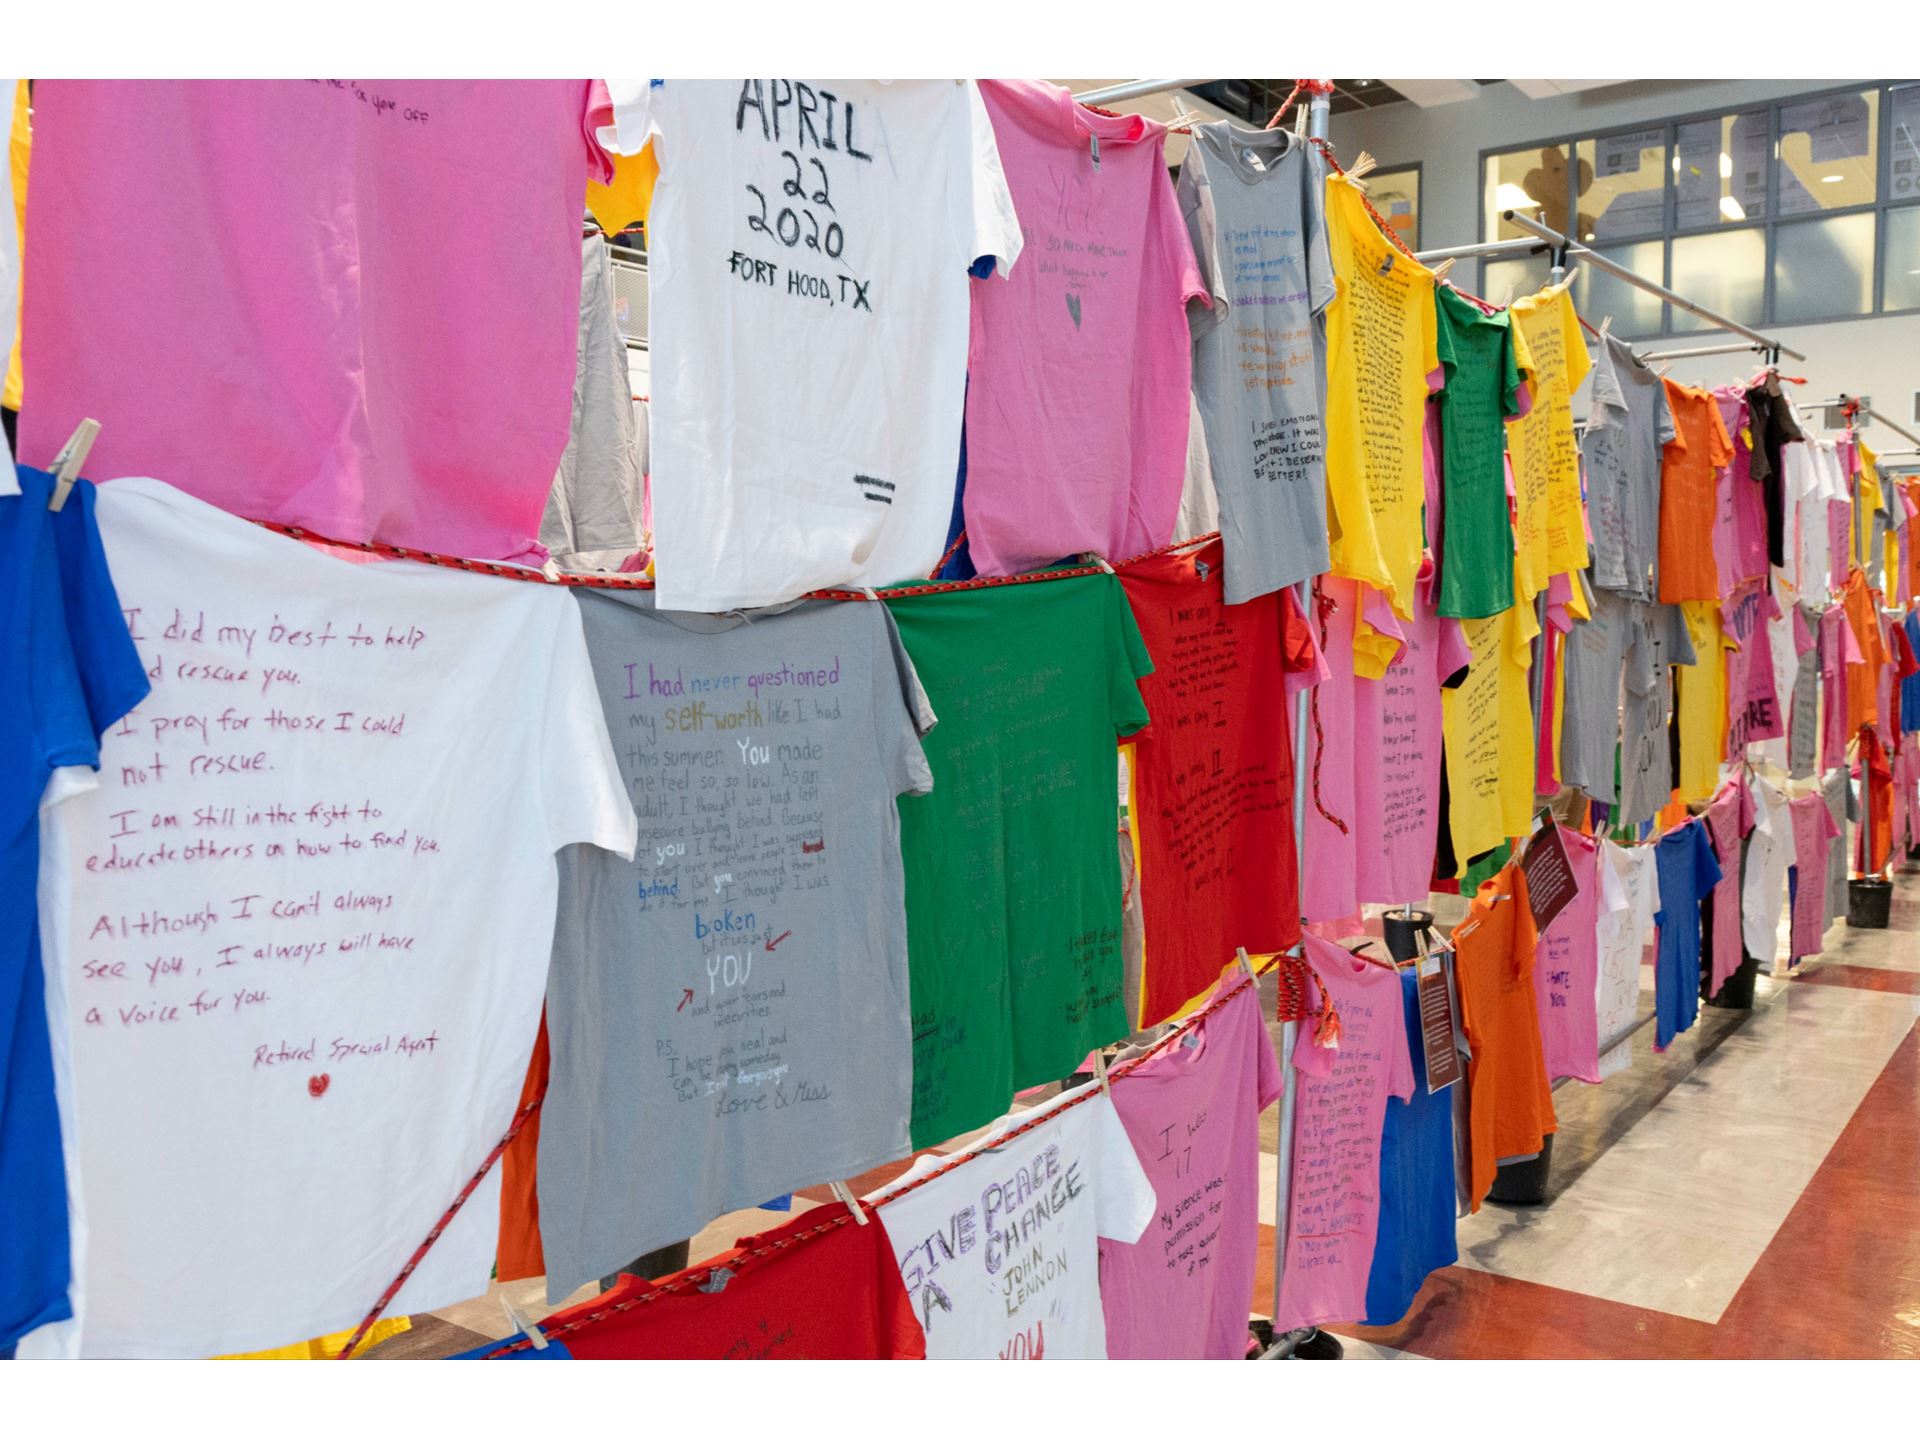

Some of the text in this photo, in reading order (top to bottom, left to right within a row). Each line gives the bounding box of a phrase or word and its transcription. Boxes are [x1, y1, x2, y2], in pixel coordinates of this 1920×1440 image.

[736, 79, 873, 162] APRIL
[782, 150, 836, 214] 22
[746, 184, 843, 258] 2020
[727, 251, 777, 286] FORT
[838, 275, 872, 313] TX
[122, 607, 146, 641] I
[164, 609, 204, 642] did
[218, 625, 256, 658] my
[348, 624, 374, 645] to
[385, 626, 425, 650] help
[177, 664, 249, 681] rescue
[263, 668, 301, 696] you.
[623, 655, 840, 699] I had never questioned
[116, 708, 405, 744] I pray for those I could
[629, 714, 656, 745] my
[768, 699, 789, 724] like
[794, 698, 806, 723] I
[815, 698, 841, 720] had
[122, 752, 274, 787] not rescue.
[627, 746, 658, 768] this
[737, 737, 770, 765] You
[777, 738, 823, 760] made
[633, 776, 654, 791] me
[661, 769, 689, 790] feel
[726, 777, 739, 786] so
[109, 810, 137, 838] I
[151, 814, 177, 828] am
[305, 802, 351, 827] fight
[358, 801, 382, 819] to
[696, 791, 736, 817] thought
[86, 844, 176, 871] educate
[184, 839, 253, 860] others
[297, 839, 331, 855] how
[340, 834, 361, 851] to
[370, 830, 406, 848] find
[415, 834, 441, 853] you.
[90, 890, 393, 940] Although I can't always
[83, 960, 126, 979] see
[216, 945, 242, 968] I
[254, 941, 326, 966] always
[339, 934, 371, 952] will
[378, 933, 414, 951] have
[706, 950, 751, 994] YOU
[86, 1007, 103, 1025] a
[189, 989, 221, 1015] for
[253, 1038, 315, 1070] Retired
[1158, 1123, 1176, 1161] I
[1176, 1146, 1192, 1179] 17
[900, 1143, 1060, 1296] GIVE PEACE
[1161, 1210, 1172, 1230] My
[1165, 1212, 1205, 1256] permission
[1003, 1241, 1042, 1296] JOHN
[1005, 1247, 1068, 1318] LENNON
[922, 1279, 952, 1333] A
